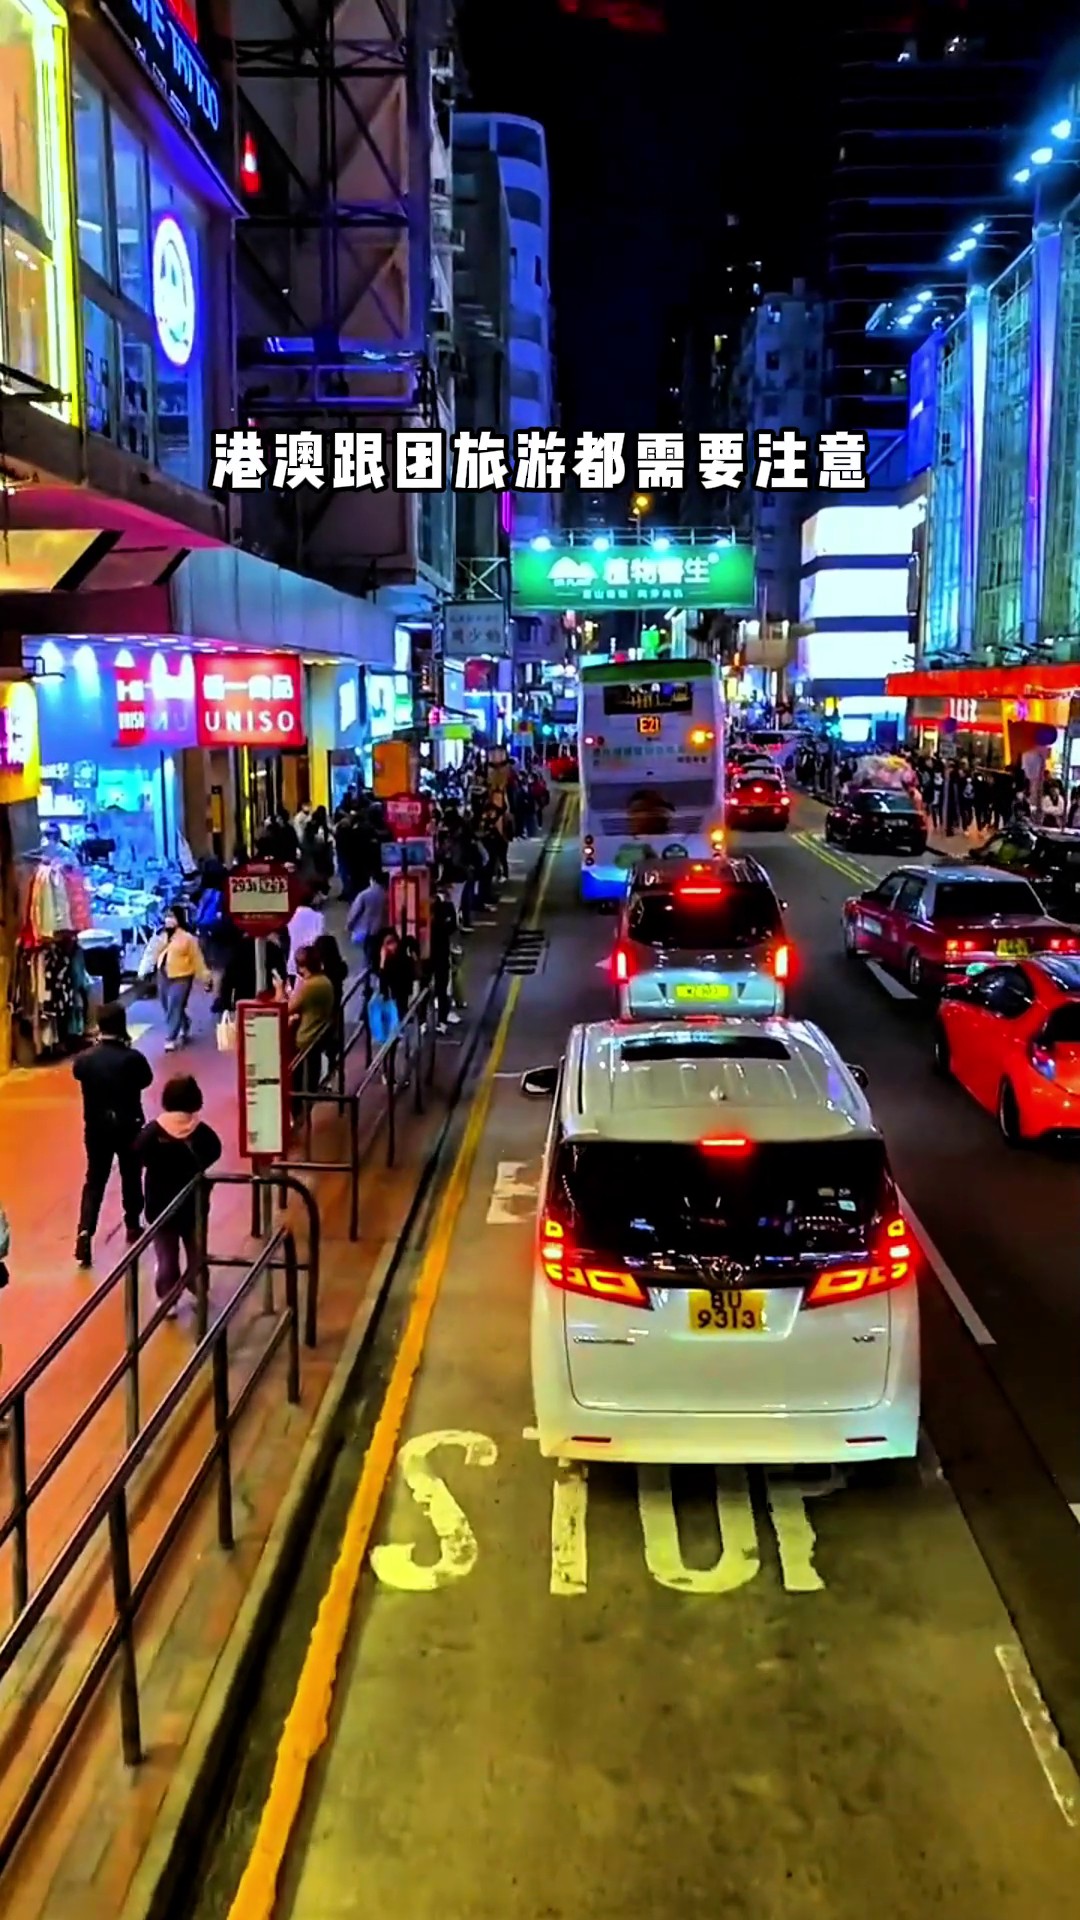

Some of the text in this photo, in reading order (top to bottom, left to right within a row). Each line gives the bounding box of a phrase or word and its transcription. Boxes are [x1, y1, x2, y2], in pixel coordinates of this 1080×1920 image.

[167, 20, 219, 131] TATTOO
[205, 710, 295, 732] UNISO
[640, 717, 659, 733] E21
[710, 1290, 742, 1309] BU
[697, 1309, 756, 1329] 9313
